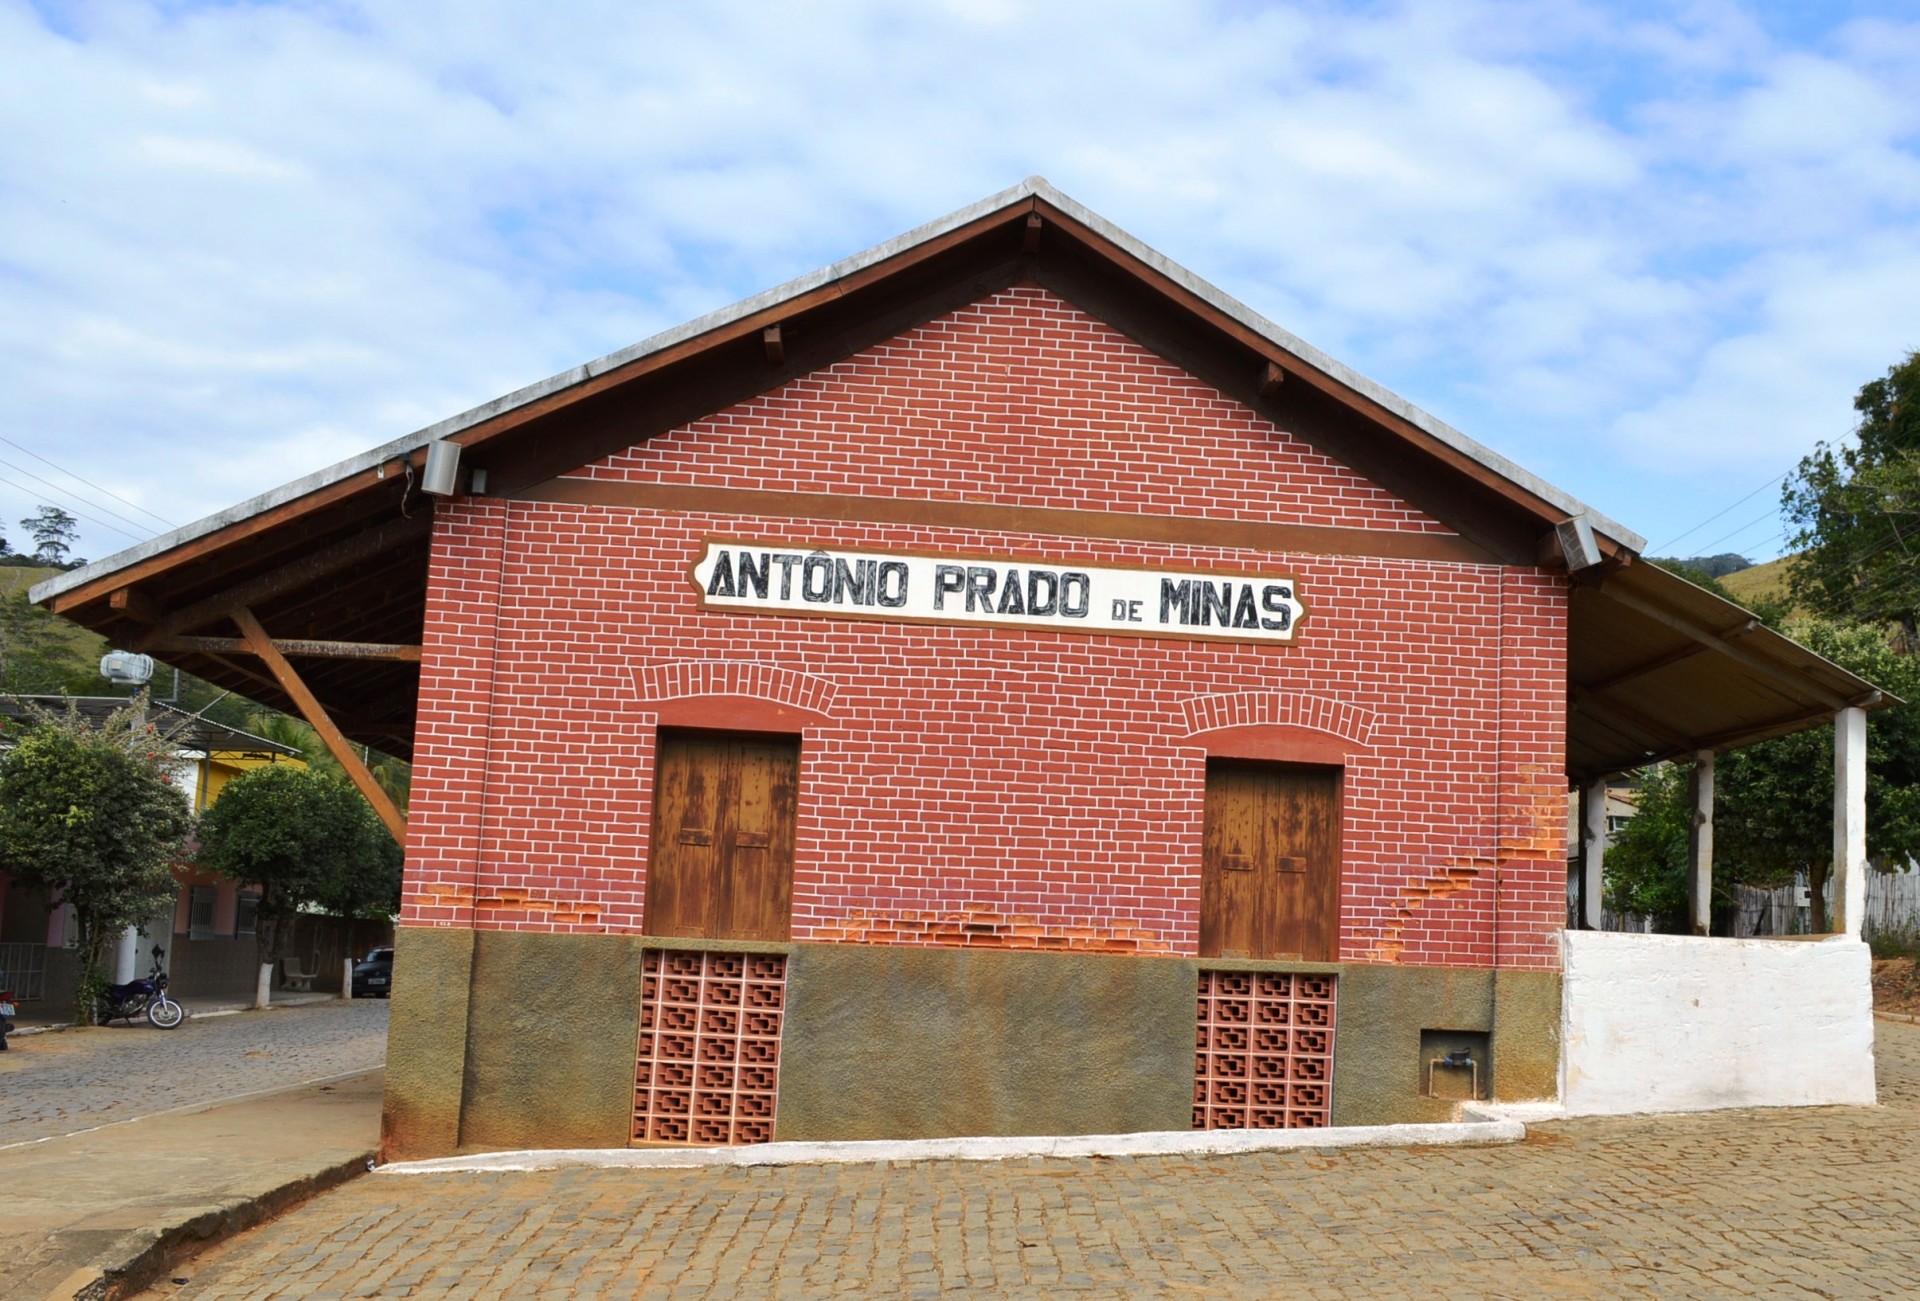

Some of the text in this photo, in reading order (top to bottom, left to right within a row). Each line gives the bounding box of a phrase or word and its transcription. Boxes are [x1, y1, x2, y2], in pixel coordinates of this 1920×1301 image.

[706, 549, 1292, 631] ANTÔNIO PRADO DE MINAS
